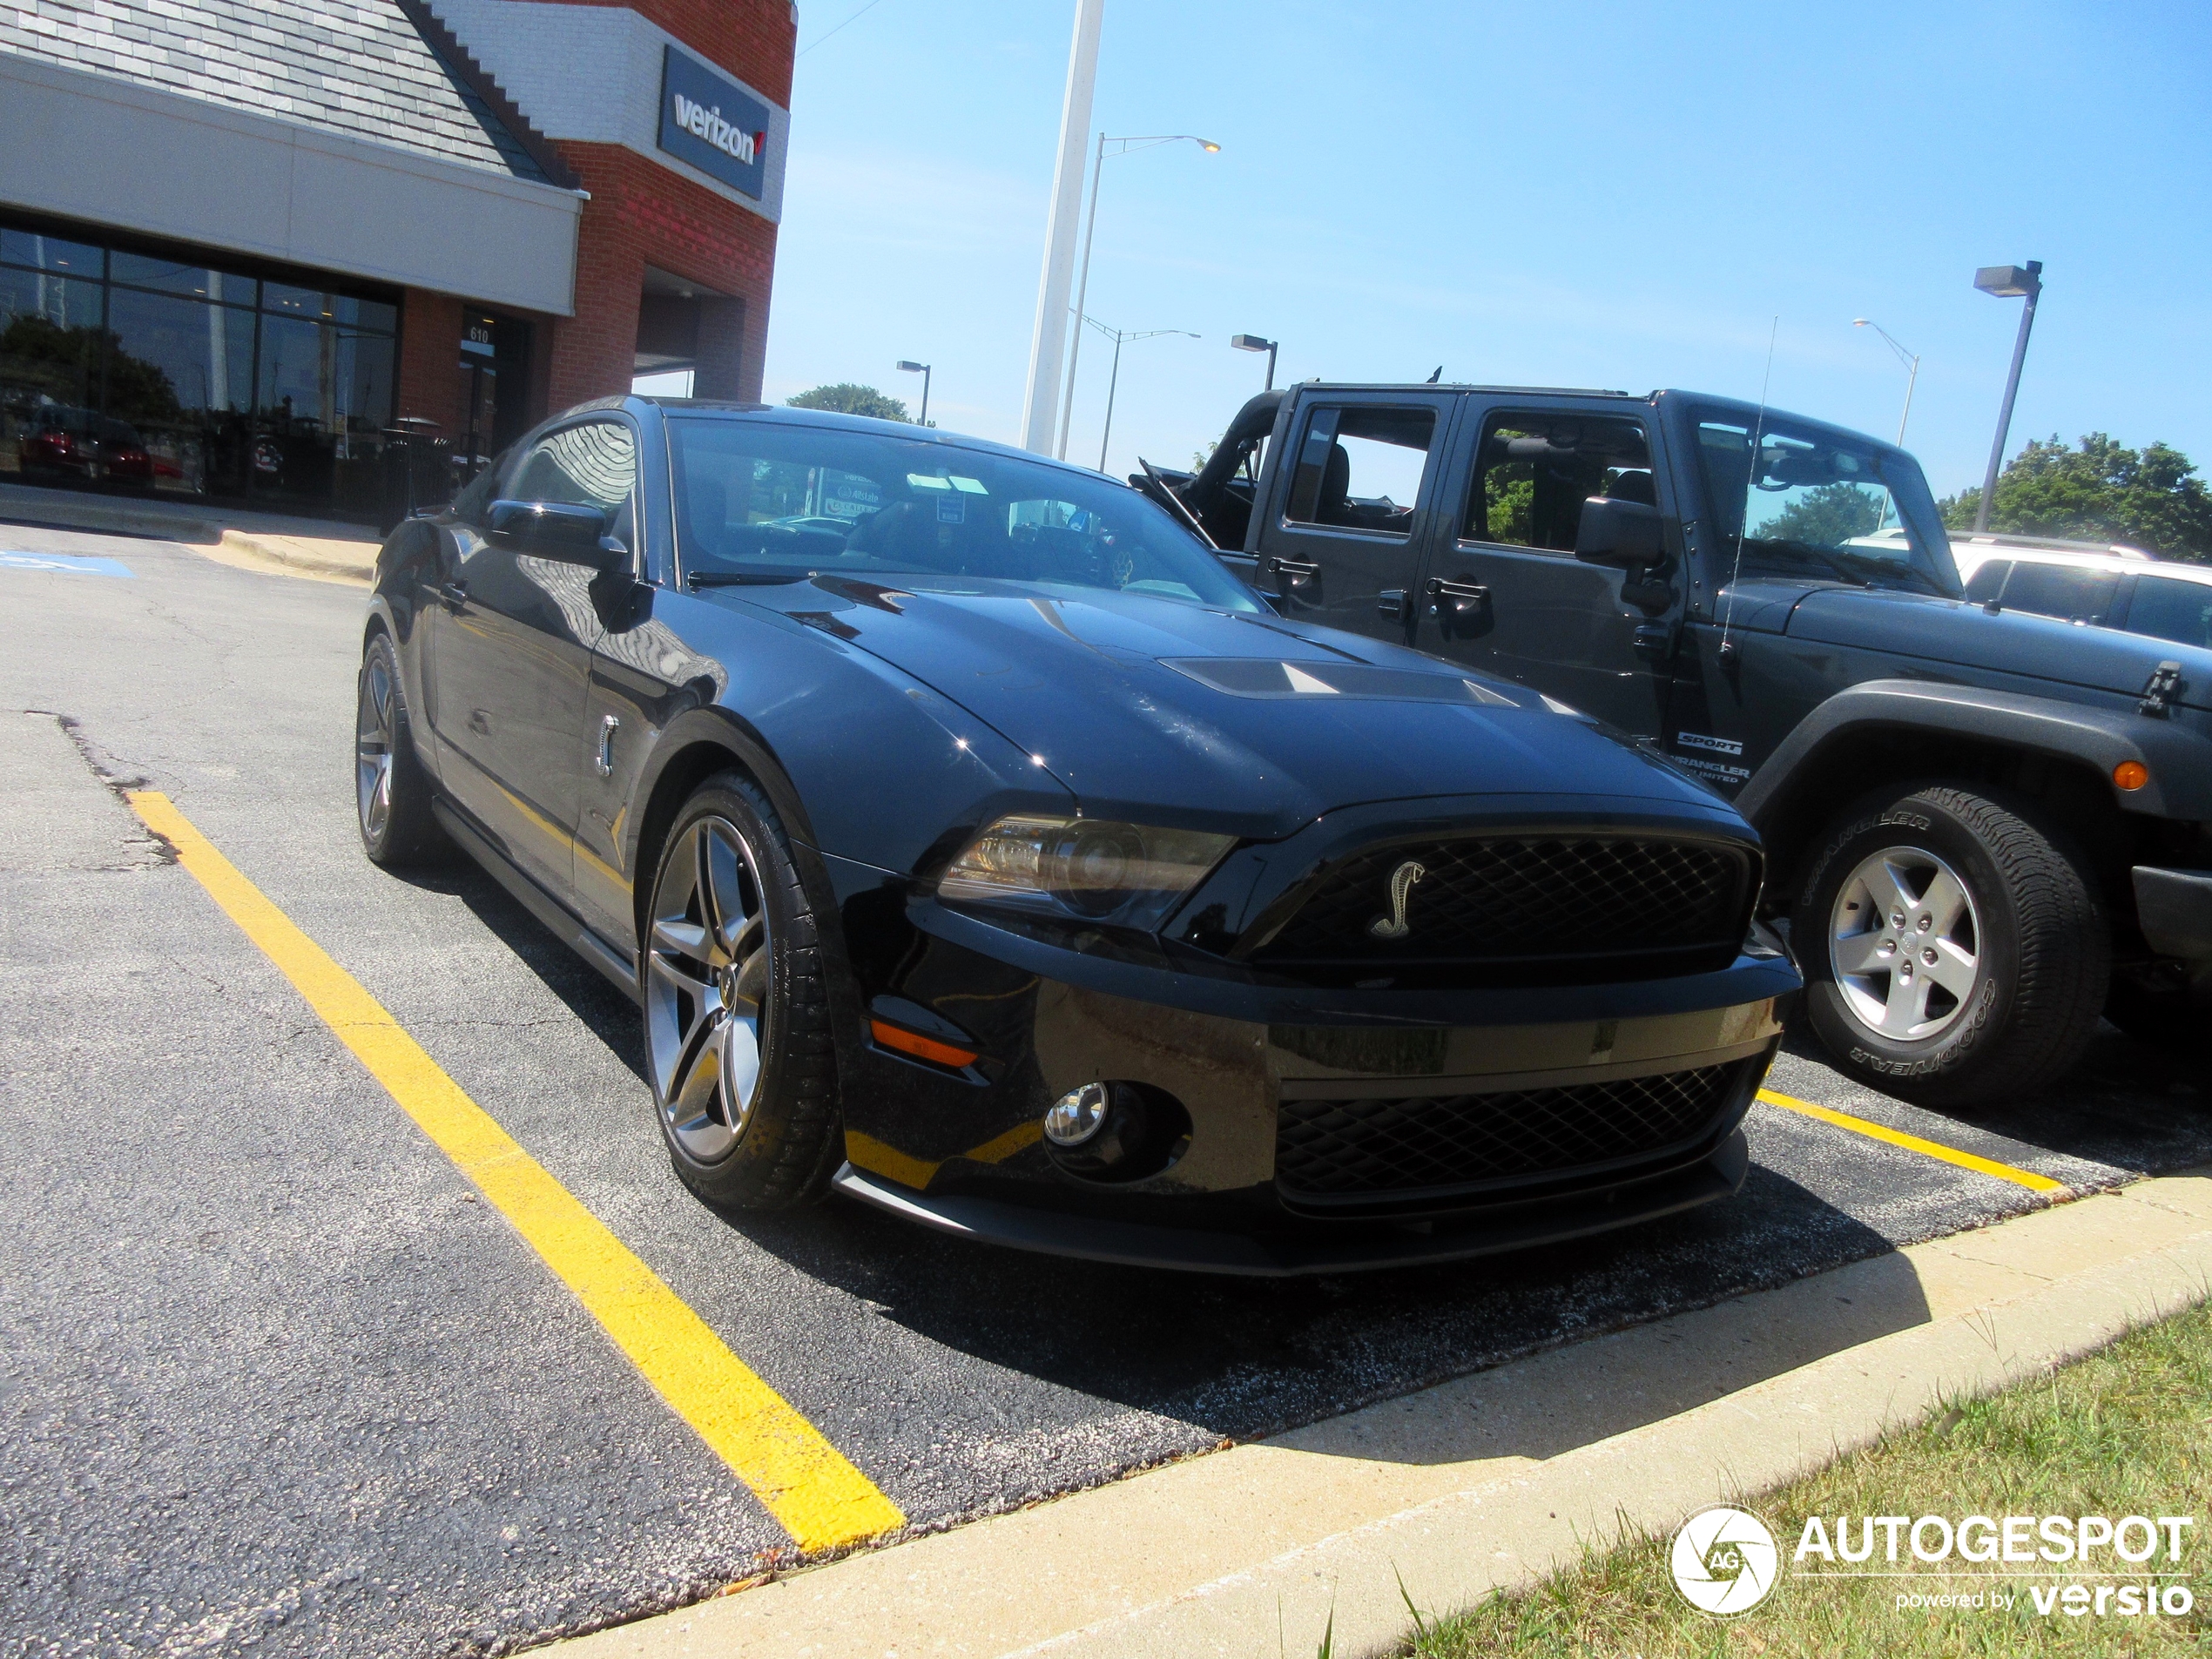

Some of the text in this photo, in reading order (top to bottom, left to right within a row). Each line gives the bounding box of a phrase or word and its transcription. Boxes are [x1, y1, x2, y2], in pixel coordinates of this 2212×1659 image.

[674, 93, 755, 165] verizon
[470, 327, 489, 343] 610
[851, 489, 879, 502] Allstate
[1682, 735, 1743, 751] SPORT
[1802, 811, 1932, 907] WRANGLER
[1850, 978, 1996, 1076] GOODYEAR
